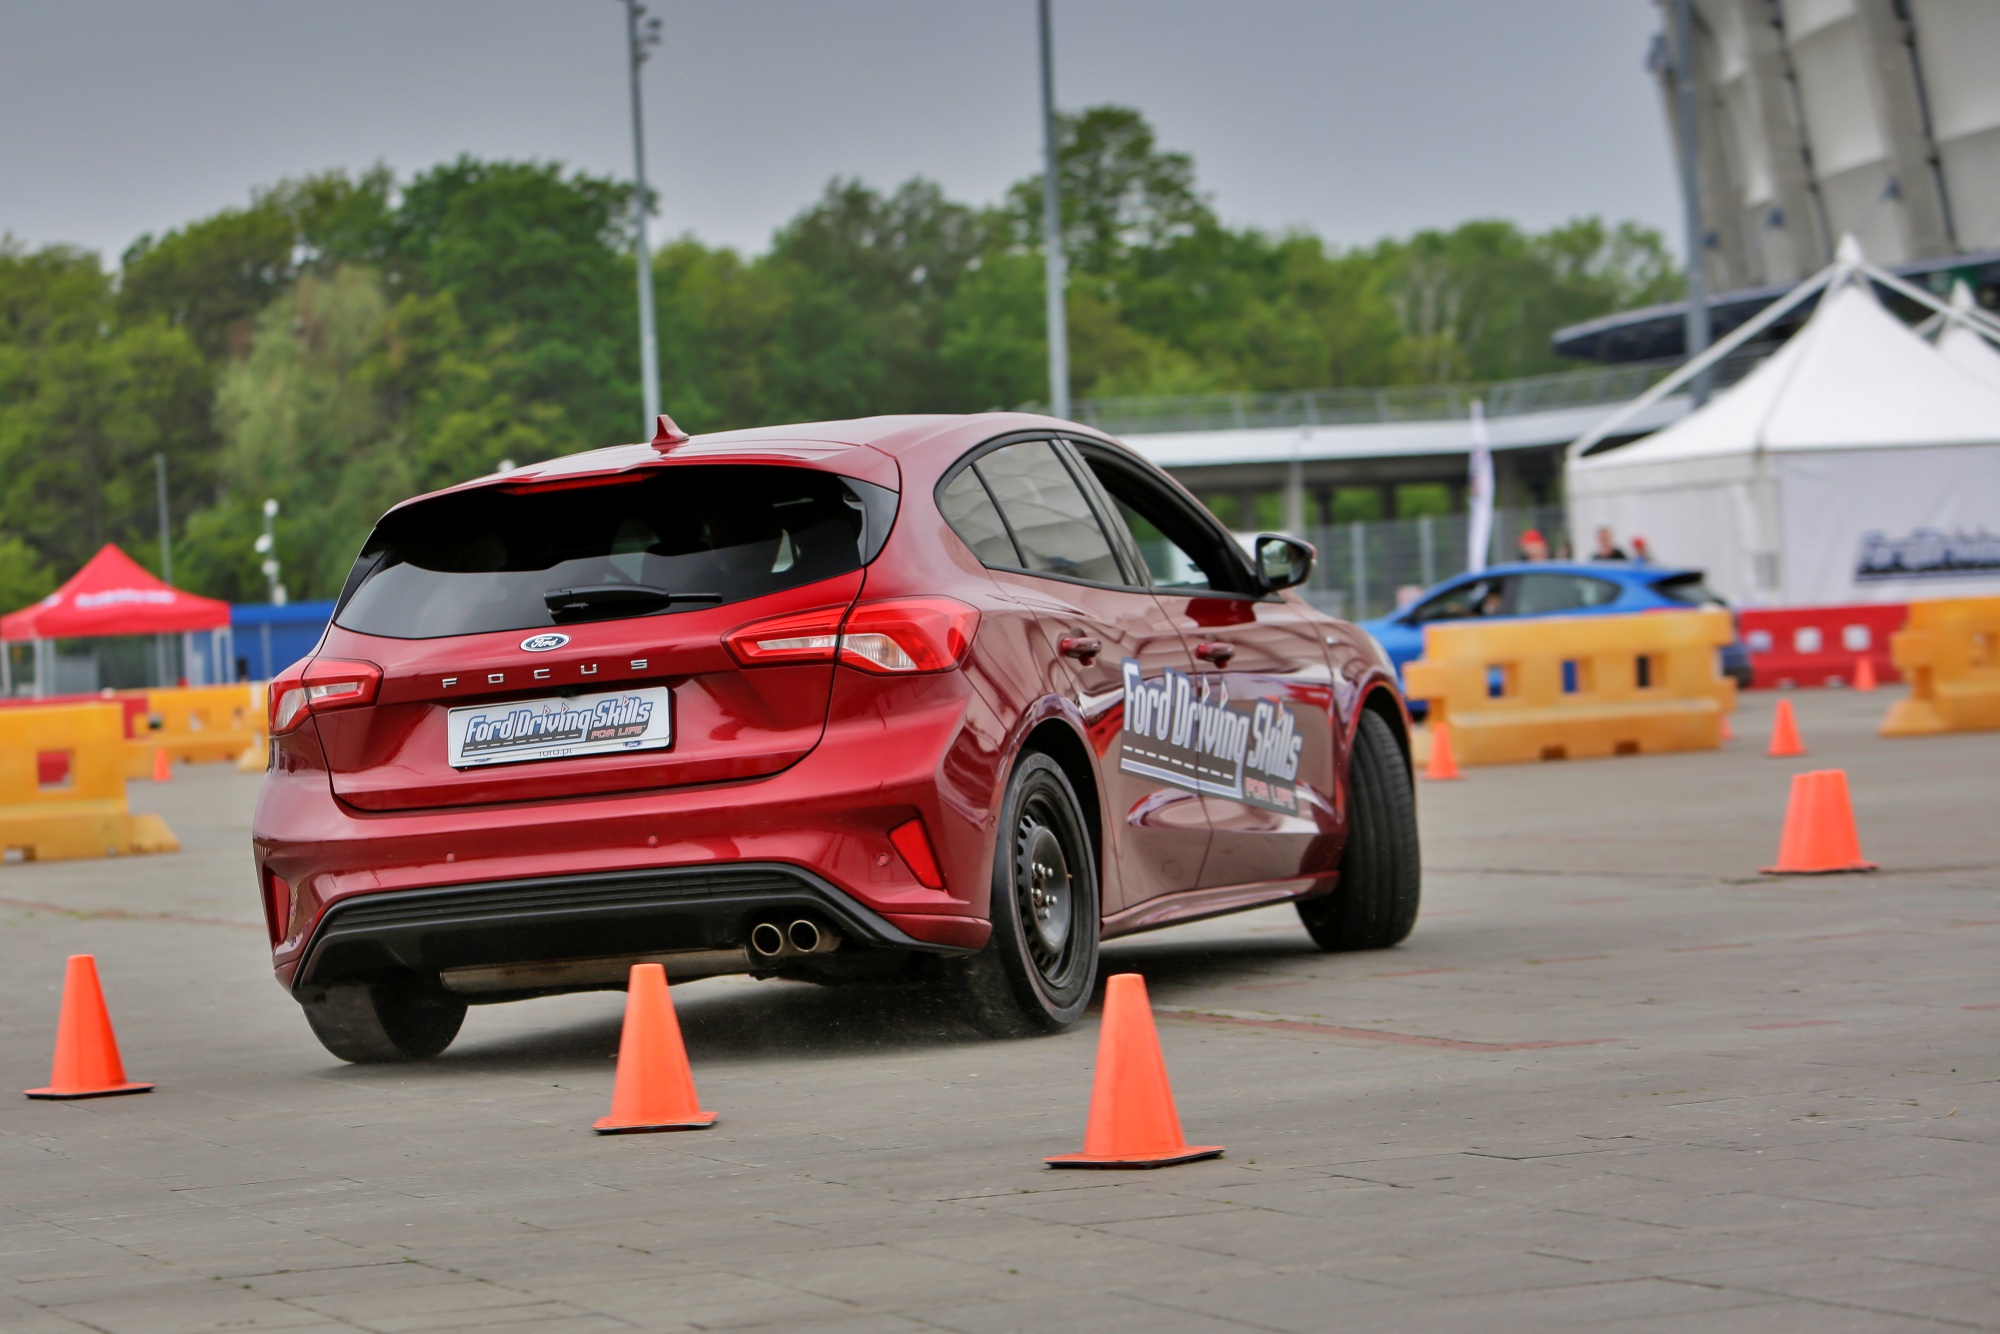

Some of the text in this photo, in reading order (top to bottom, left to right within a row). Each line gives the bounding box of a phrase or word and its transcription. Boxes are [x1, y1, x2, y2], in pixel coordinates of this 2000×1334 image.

[530, 636, 559, 648] Ford
[442, 658, 648, 689] FOCUS
[465, 695, 653, 743] Ford Driving Skills
[591, 725, 643, 739] FOR LIFE
[1122, 657, 1303, 796] Ford Driving Skills
[1245, 777, 1270, 802] FOR
